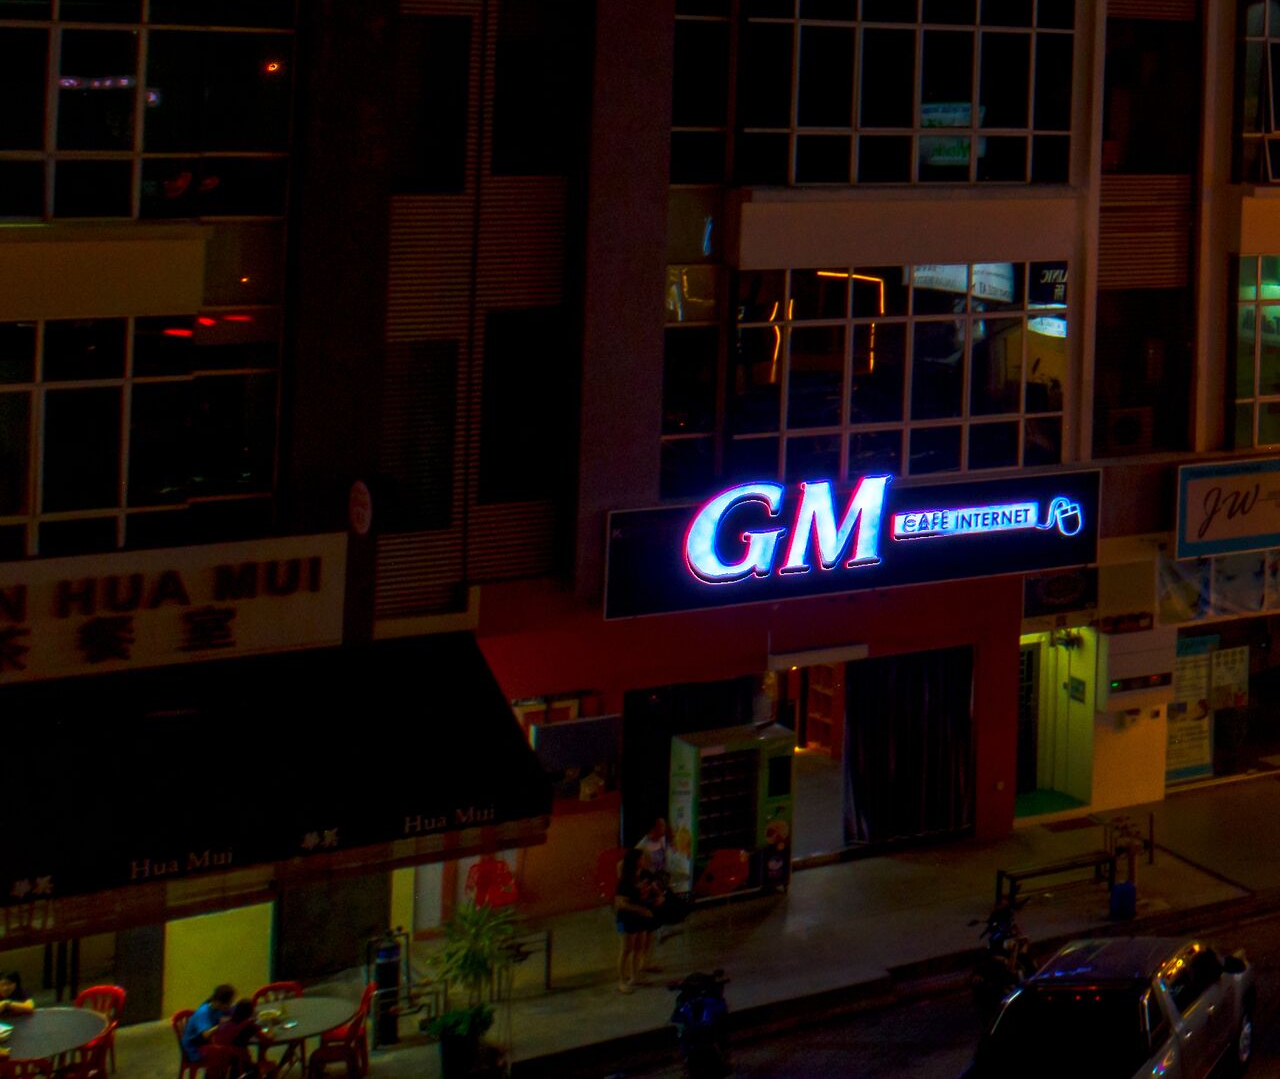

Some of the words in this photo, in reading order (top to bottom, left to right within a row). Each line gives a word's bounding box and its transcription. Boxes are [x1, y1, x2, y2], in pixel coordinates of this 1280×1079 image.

[684, 472, 896, 585] GM
[952, 506, 1032, 530] INTERNET
[1198, 484, 1260, 539] JW
[53, 570, 191, 619] HUA
[212, 556, 323, 601] MUI
[404, 813, 448, 833] Hua
[455, 804, 497, 825] Mui
[129, 856, 181, 881] Hua
[187, 847, 235, 872] Mui
